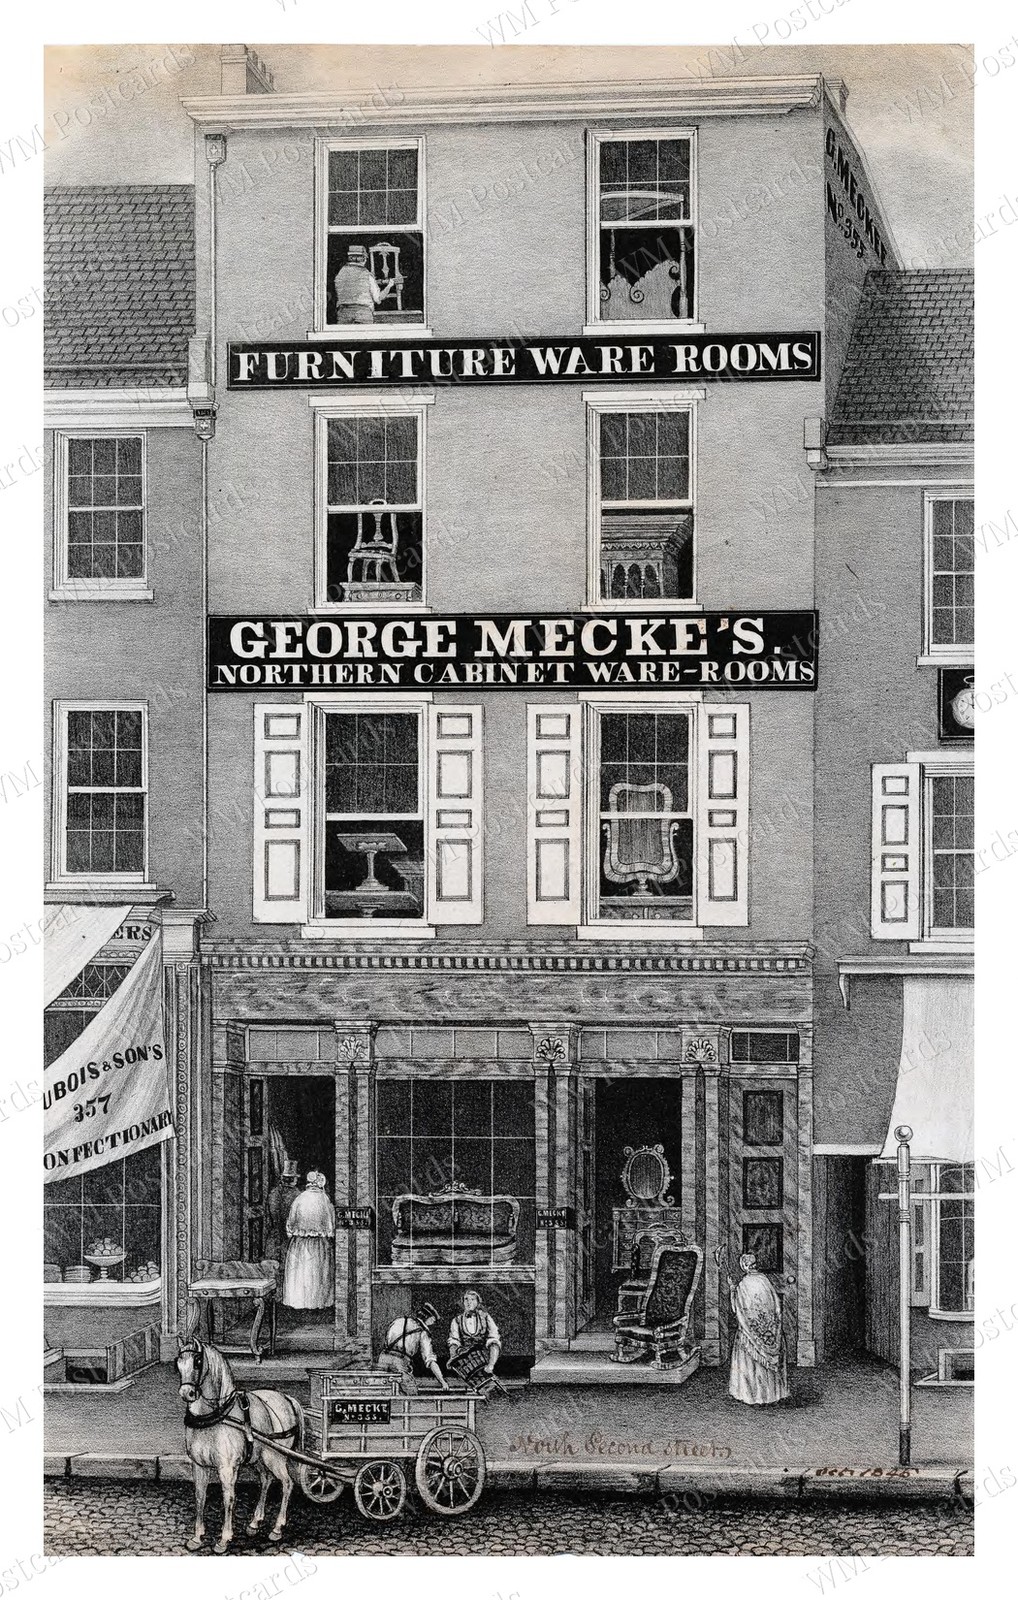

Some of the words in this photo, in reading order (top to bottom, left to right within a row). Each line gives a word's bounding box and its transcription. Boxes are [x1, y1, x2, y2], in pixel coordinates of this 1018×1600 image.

[234, 348, 516, 381] FURNITURE
[527, 345, 655, 375] WARE
[668, 342, 813, 373] ROOMS
[229, 620, 457, 659] GEORGE
[473, 617, 781, 657] MECKE'S.
[212, 663, 405, 685] NORTHERN
[414, 662, 575, 684] CABINET
[71, 1092, 113, 1123] 357
